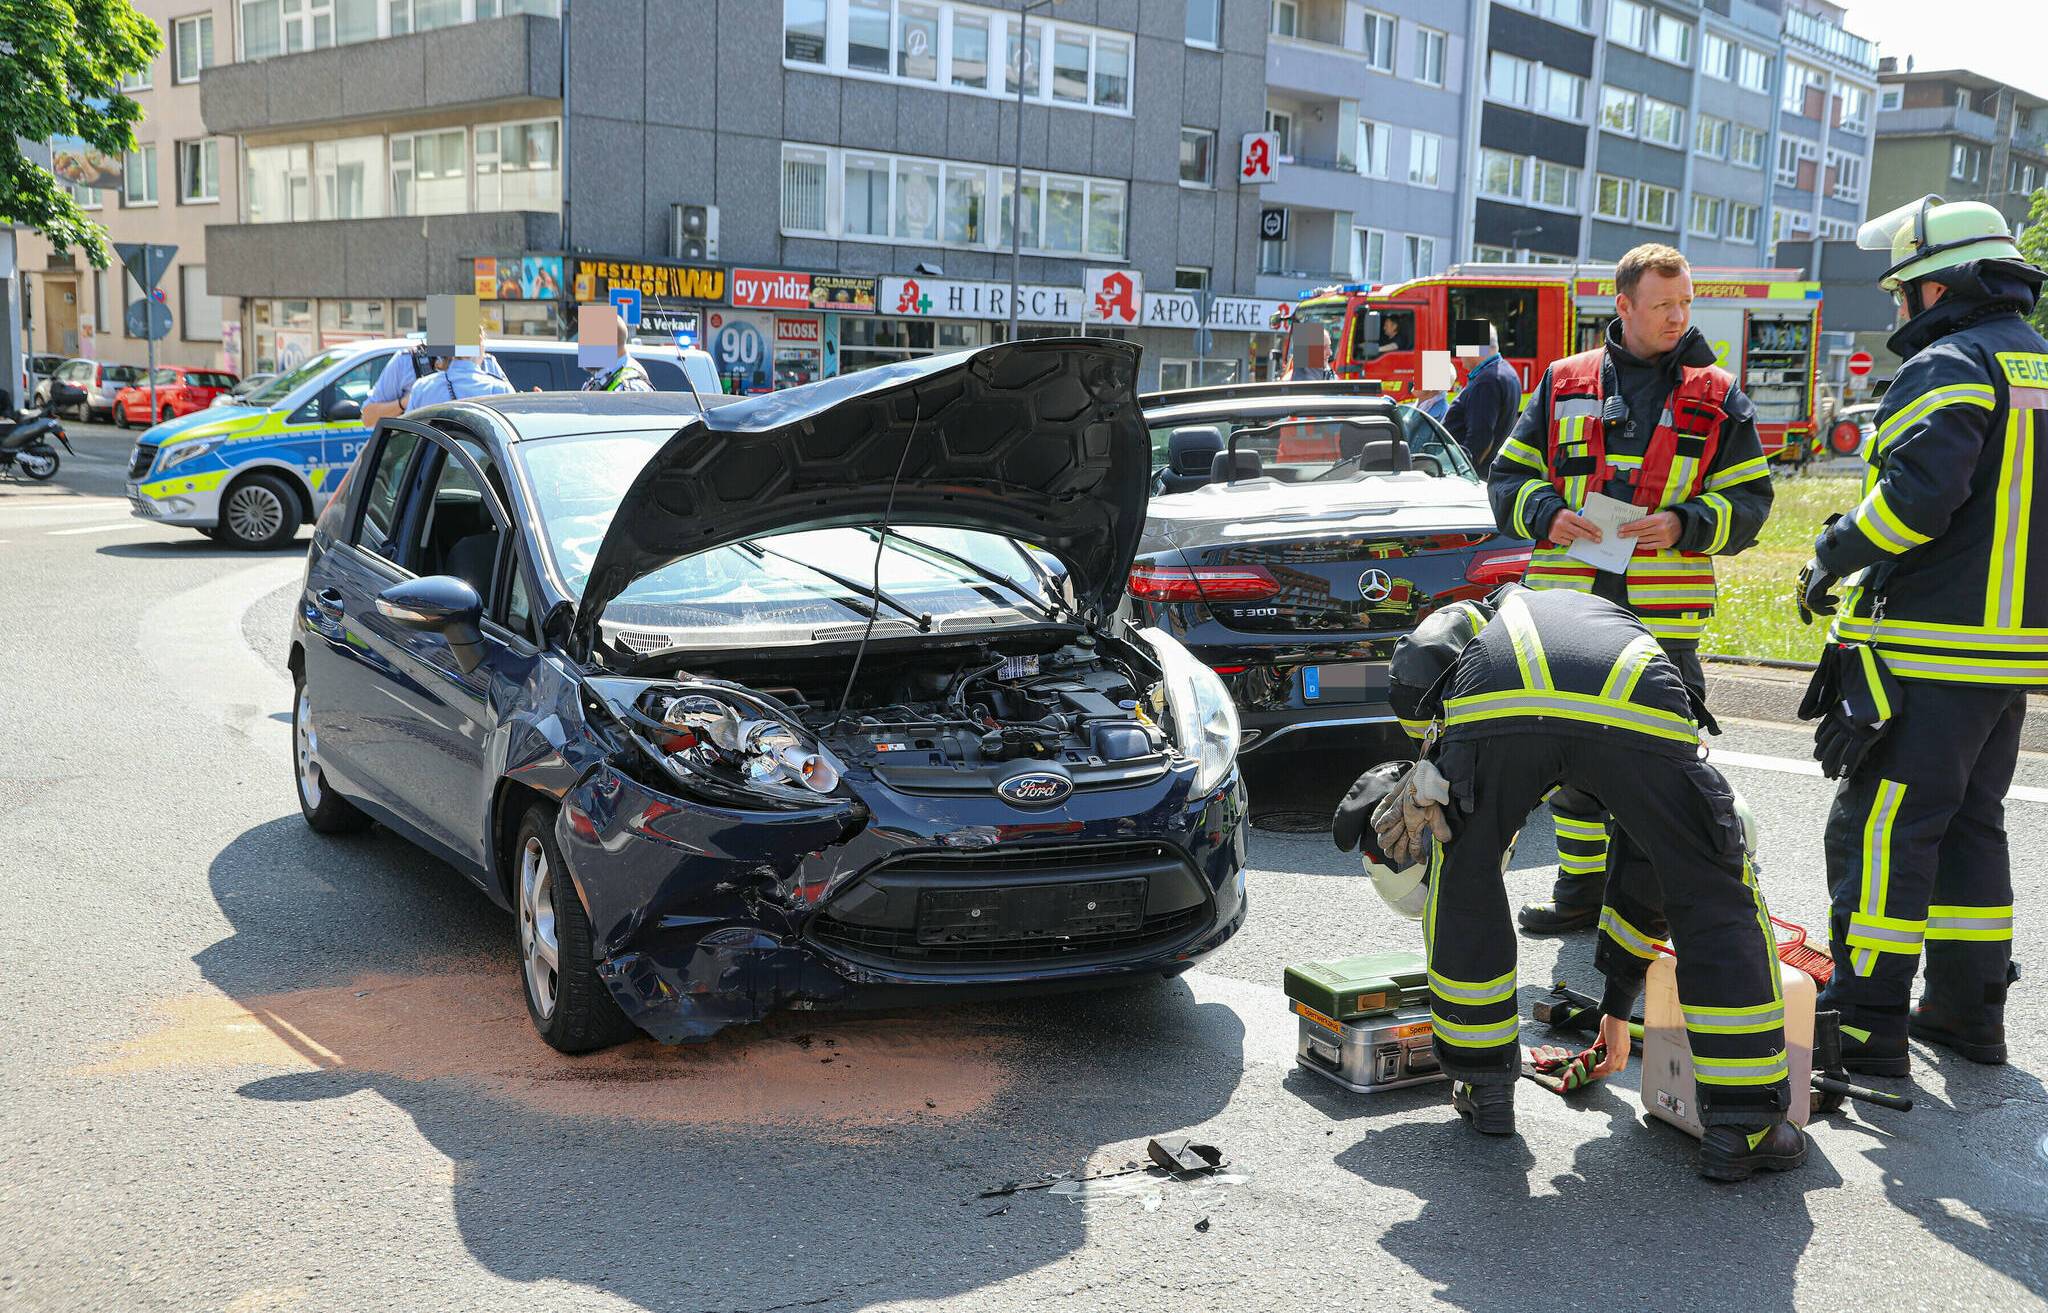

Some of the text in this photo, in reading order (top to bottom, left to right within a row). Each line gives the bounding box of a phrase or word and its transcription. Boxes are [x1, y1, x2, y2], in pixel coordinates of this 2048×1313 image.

[581, 261, 668, 282] WESTERN
[678, 268, 725, 300] WU
[735, 279, 758, 303] ay
[814, 276, 875, 290] GOLDANKAUF
[1694, 283, 1748, 298] PPERTAL
[948, 286, 1068, 316] HIRSCH
[1151, 298, 1262, 326] APOHEKE
[641, 318, 652, 330] &
[654, 318, 697, 332] Verkauf
[777, 322, 817, 338] KIOSK
[721, 328, 758, 364] 90
[2006, 359, 2048, 381] FEUE
[342, 442, 366, 458] PO
[1233, 608, 1278, 617] E 300
[1016, 779, 1057, 798] Ford
[1408, 1025, 1432, 1036] Sperrw
